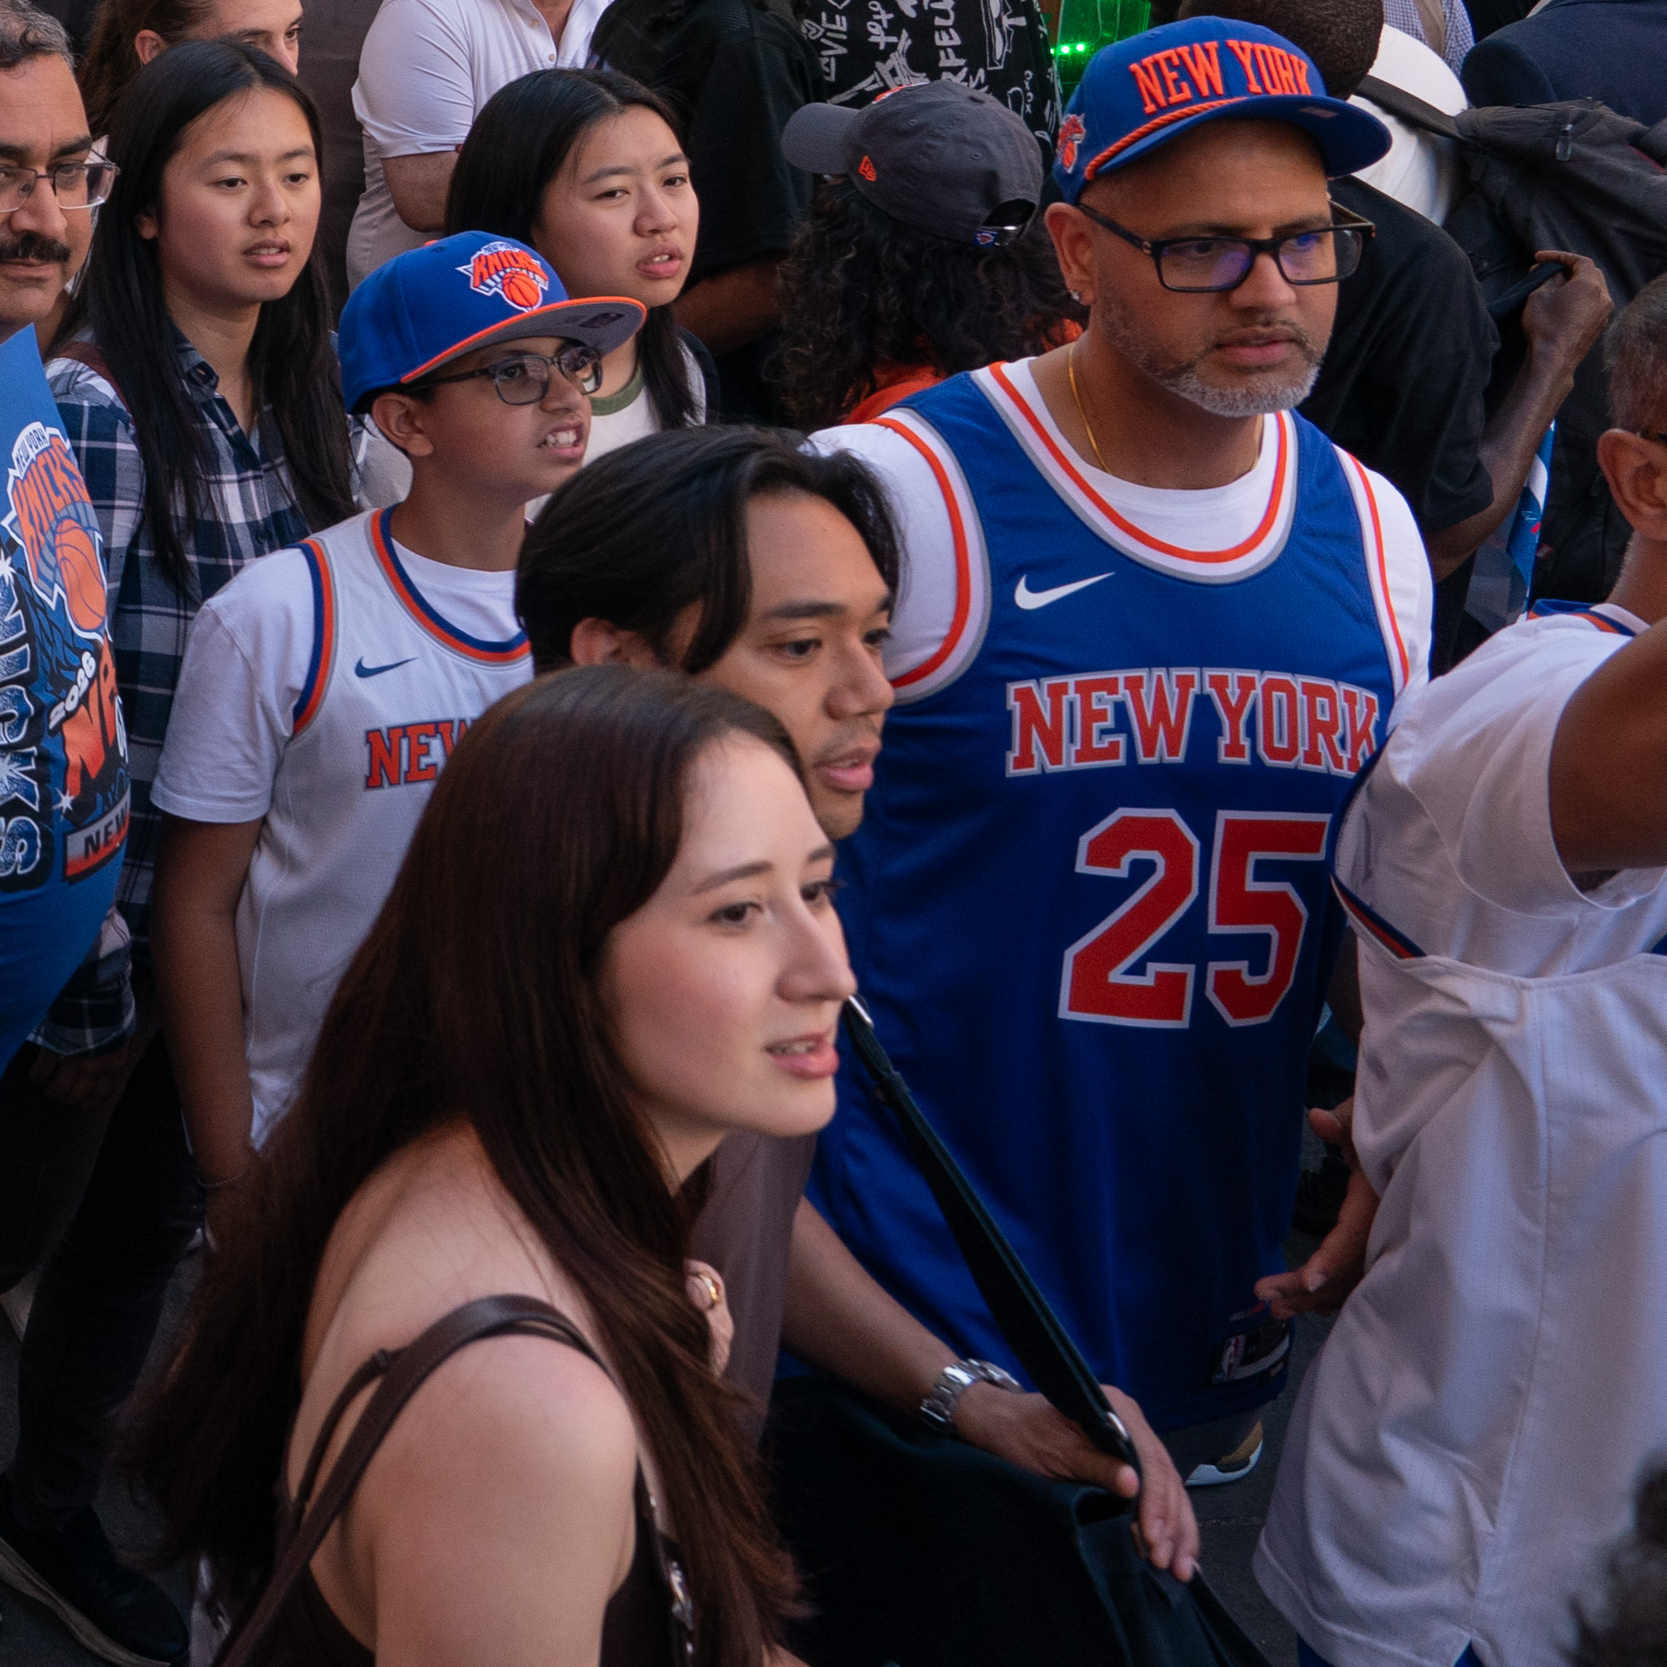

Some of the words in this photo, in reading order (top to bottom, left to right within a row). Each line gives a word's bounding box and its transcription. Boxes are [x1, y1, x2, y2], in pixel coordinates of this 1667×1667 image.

[1128, 40, 1223, 115] NEW
[1223, 37, 1313, 97] YORK
[472, 248, 548, 289] KNICKS
[11, 434, 83, 542] KNICKS
[1005, 671, 1195, 777] NEW
[1192, 667, 1389, 780] YORK
[1058, 808, 1336, 1029] 25
